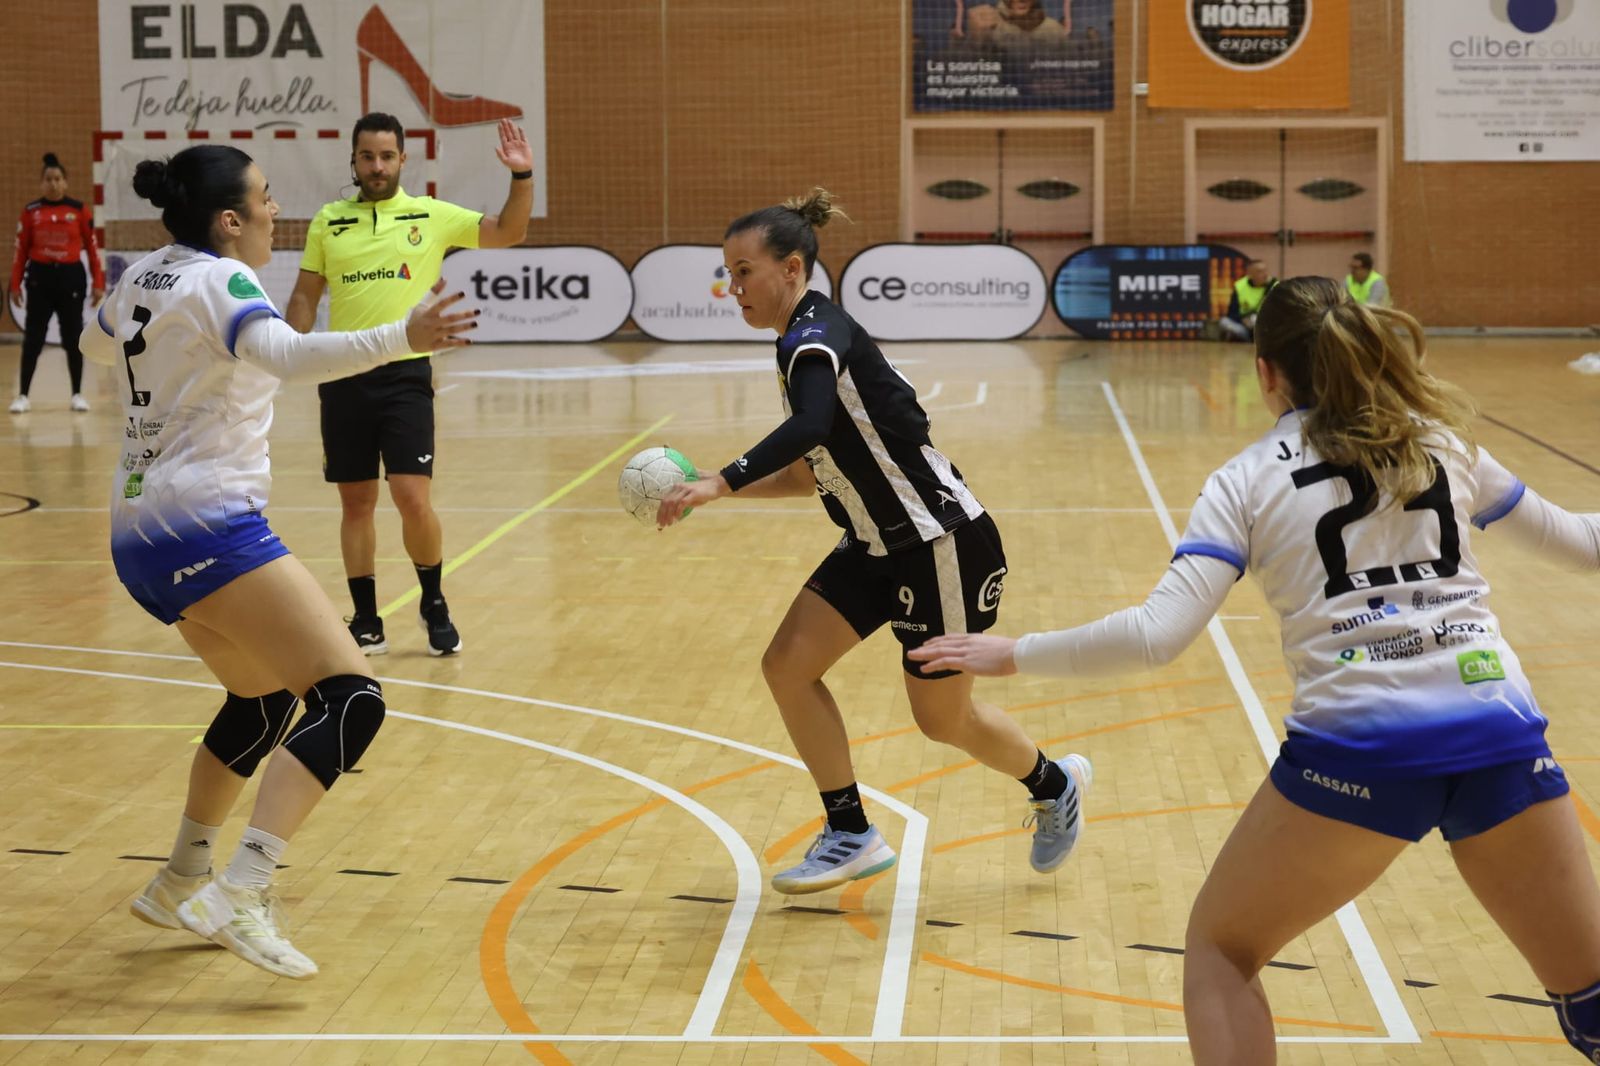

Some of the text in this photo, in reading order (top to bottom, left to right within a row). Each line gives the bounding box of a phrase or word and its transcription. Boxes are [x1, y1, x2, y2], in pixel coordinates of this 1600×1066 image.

[1201, 5, 1289, 27] HOGAR
[131, 4, 323, 59] ELDA
[1219, 38, 1288, 53] express
[1449, 36, 1600, 58] clibersalu
[926, 59, 1002, 71] La sonrisa
[927, 74, 999, 84] es nuestra
[926, 87, 967, 98] mayor
[121, 76, 338, 130] Te deja huella.
[342, 268, 395, 284] helvetia
[471, 265, 590, 301] teika
[1119, 275, 1201, 292] MIPE
[858, 276, 1030, 301] ce consulting
[641, 302, 736, 318] acabados
[123, 305, 152, 406] 2
[898, 585, 915, 616] 9
[1427, 588, 1481, 605] GENERALITA
[1331, 608, 1385, 635] suma
[1366, 627, 1421, 648] FUNDACIÓN
[1367, 636, 1423, 655] TRINIDAD
[1369, 646, 1424, 664] ALFONSO
[1463, 660, 1501, 677] CRC
[1302, 768, 1371, 800] CASSATA
